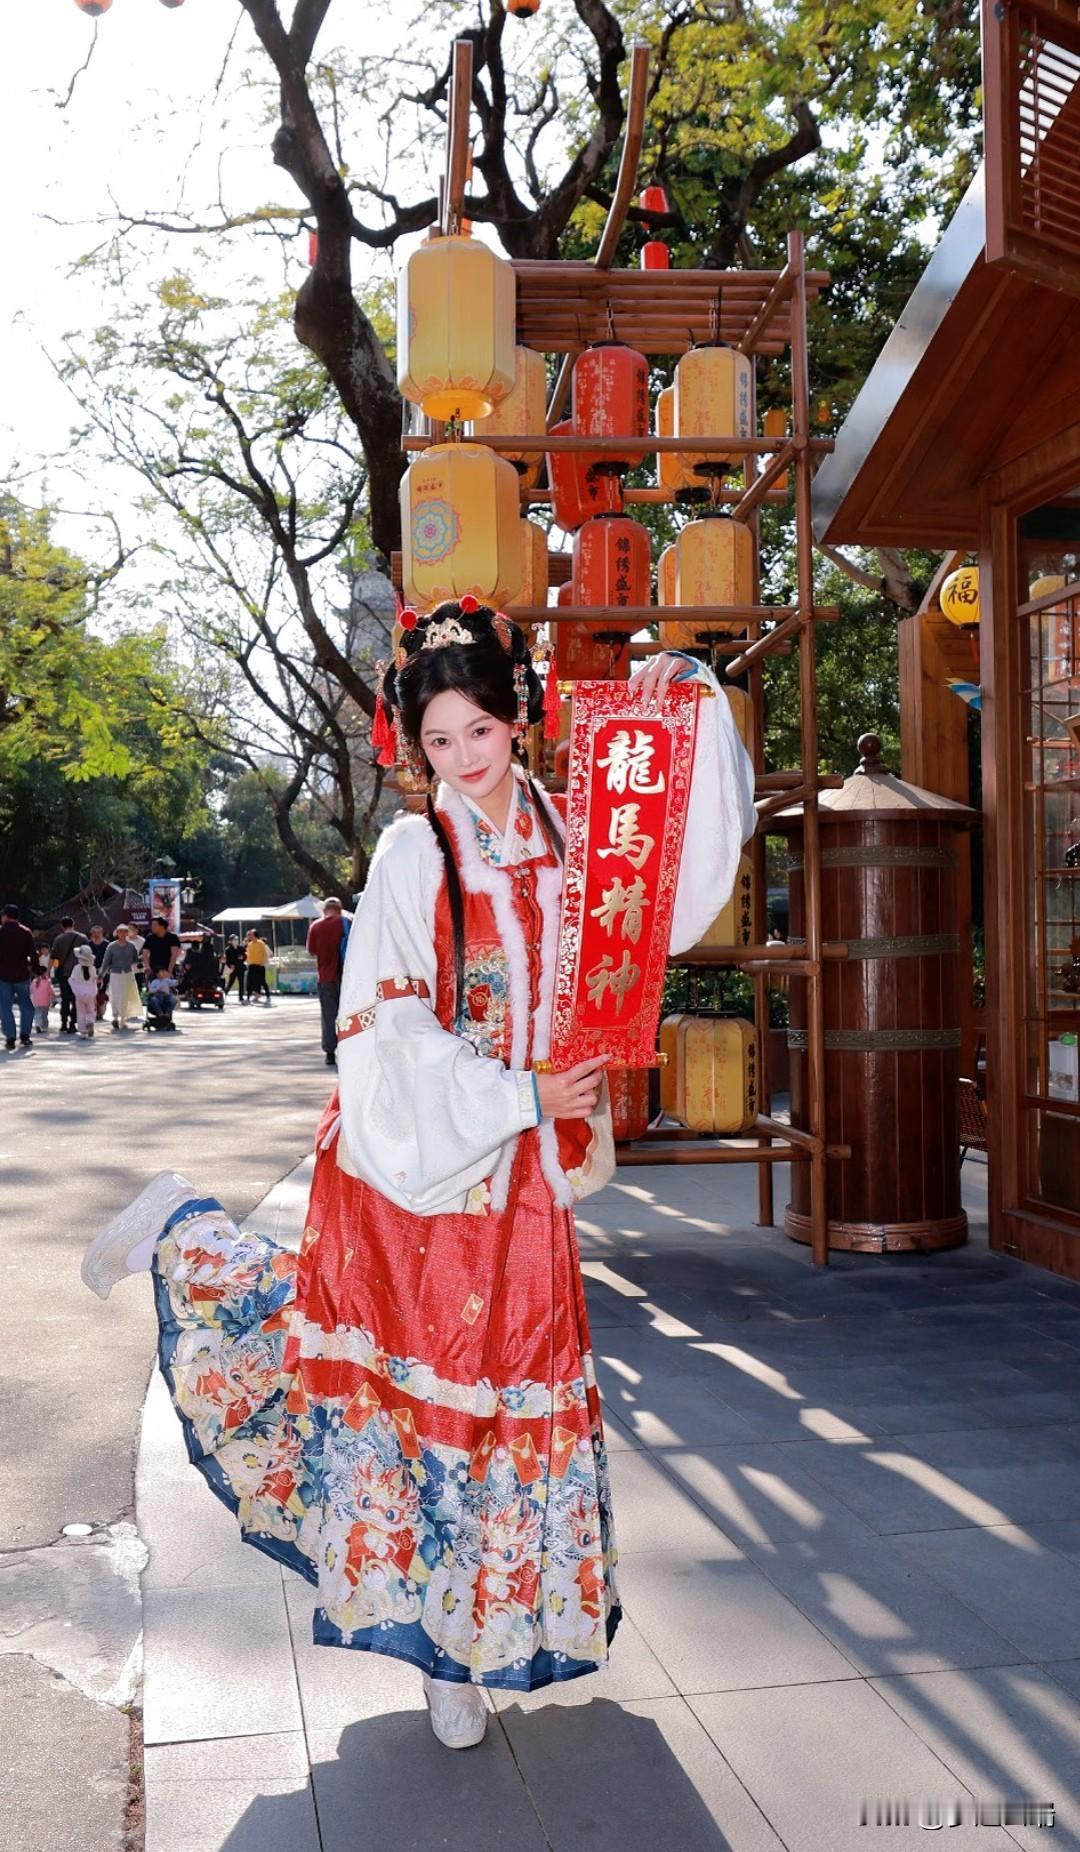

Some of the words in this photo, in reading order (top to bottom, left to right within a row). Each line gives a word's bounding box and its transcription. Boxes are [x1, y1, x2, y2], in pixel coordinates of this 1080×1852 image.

[946, 576, 978, 605] 福
[584, 729, 666, 1017] 龍馬精神
